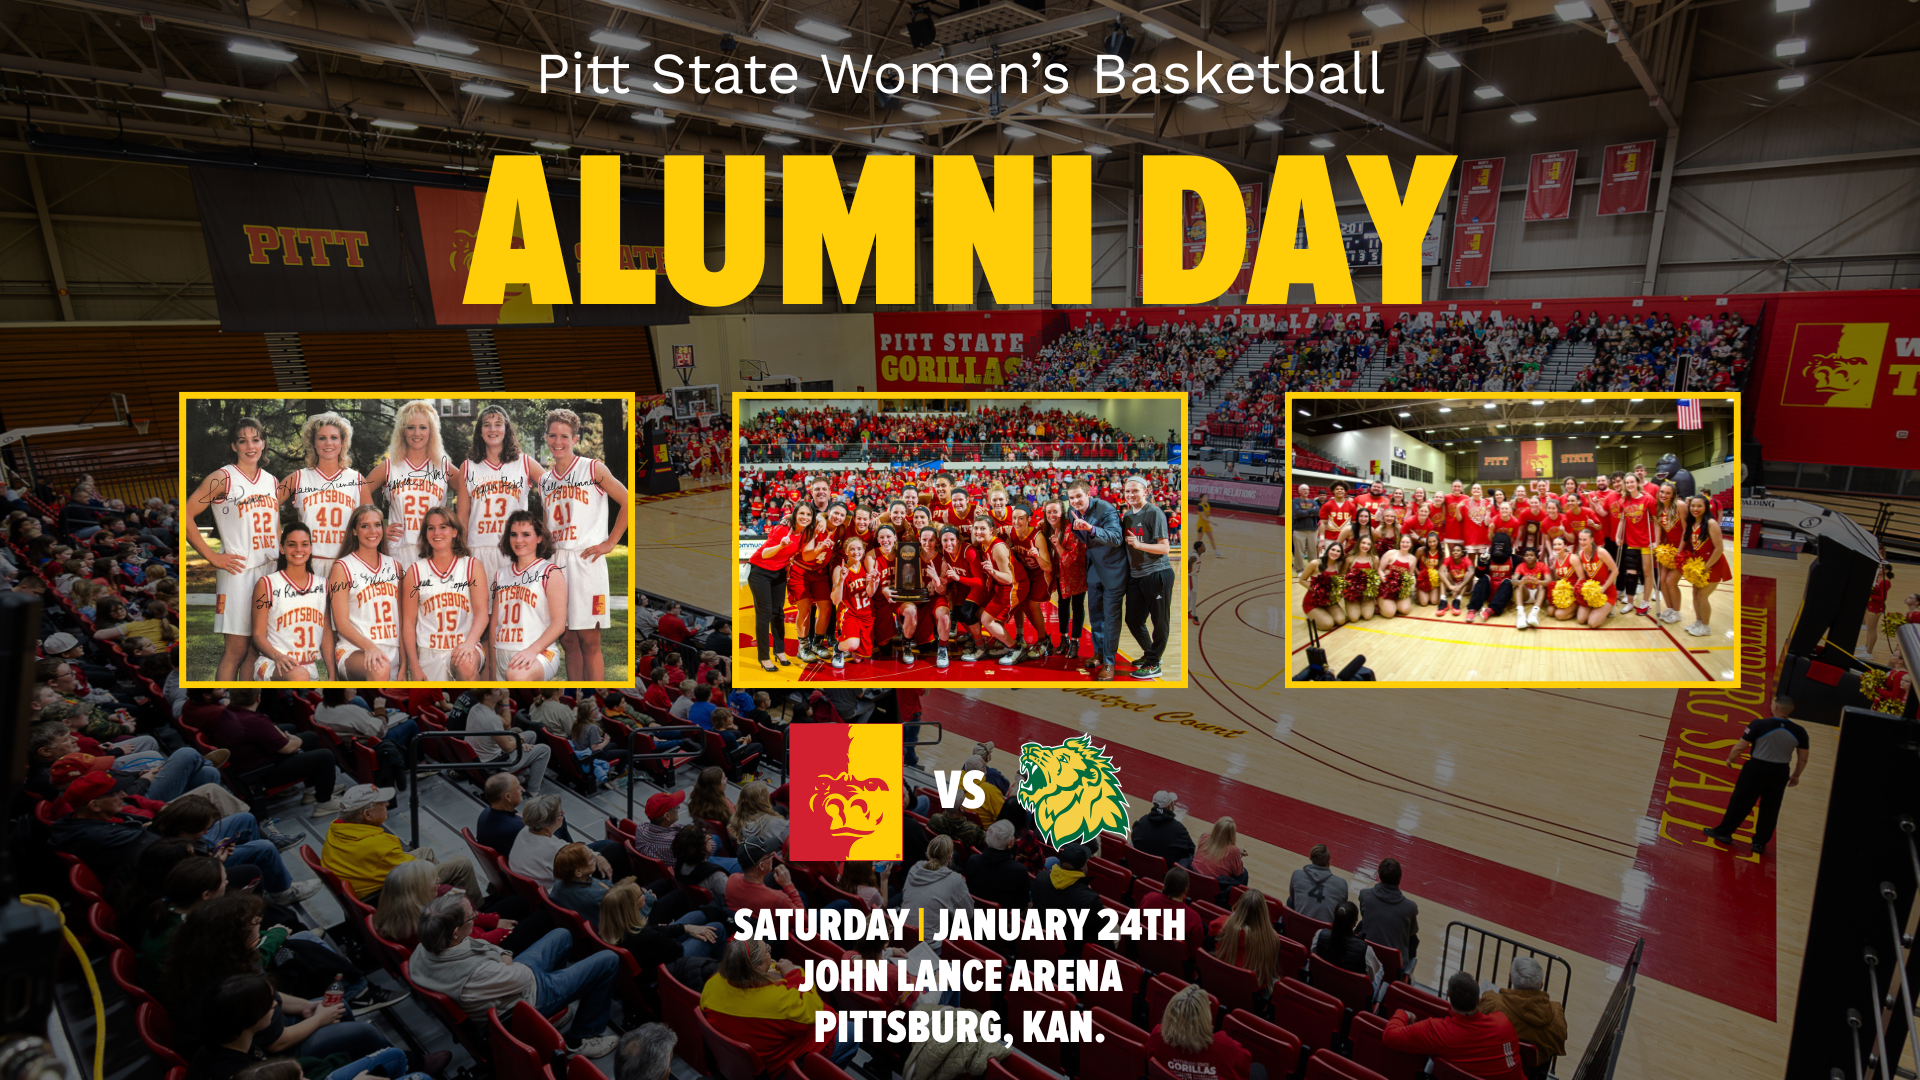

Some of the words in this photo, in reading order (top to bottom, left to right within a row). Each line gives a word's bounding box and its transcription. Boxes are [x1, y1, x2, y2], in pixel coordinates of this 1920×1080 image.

[243, 224, 369, 268] PITT
[880, 333, 933, 351] PITT
[943, 333, 1023, 353] STATE
[677, 354, 690, 366] 24
[881, 355, 1022, 386] GORILLAS
[1484, 456, 1510, 466] PITT
[1560, 453, 1594, 463] STATE
[1223, 487, 1257, 499] RELATIONS
[404, 495, 430, 516] 25
[483, 497, 508, 518] 13
[552, 502, 572, 527] 41
[1330, 512, 1350, 520] PSU
[253, 512, 272, 533] 22
[316, 507, 343, 528] 40
[815, 551, 828, 565] 4
[423, 592, 470, 617] PITTSBURG
[854, 590, 871, 610] 12
[276, 607, 325, 632] PITTSBUR
[373, 600, 393, 624] 12
[436, 610, 458, 633] 15
[502, 602, 521, 625] 10
[293, 626, 316, 648] 31
[370, 623, 398, 640] STATE
[429, 633, 464, 649] STATE
[496, 627, 524, 643] STATE
[1152, 711, 1248, 739] Court
[1307, 884, 1326, 903] 4
[1167, 1060, 1217, 1075] GORILLAS
